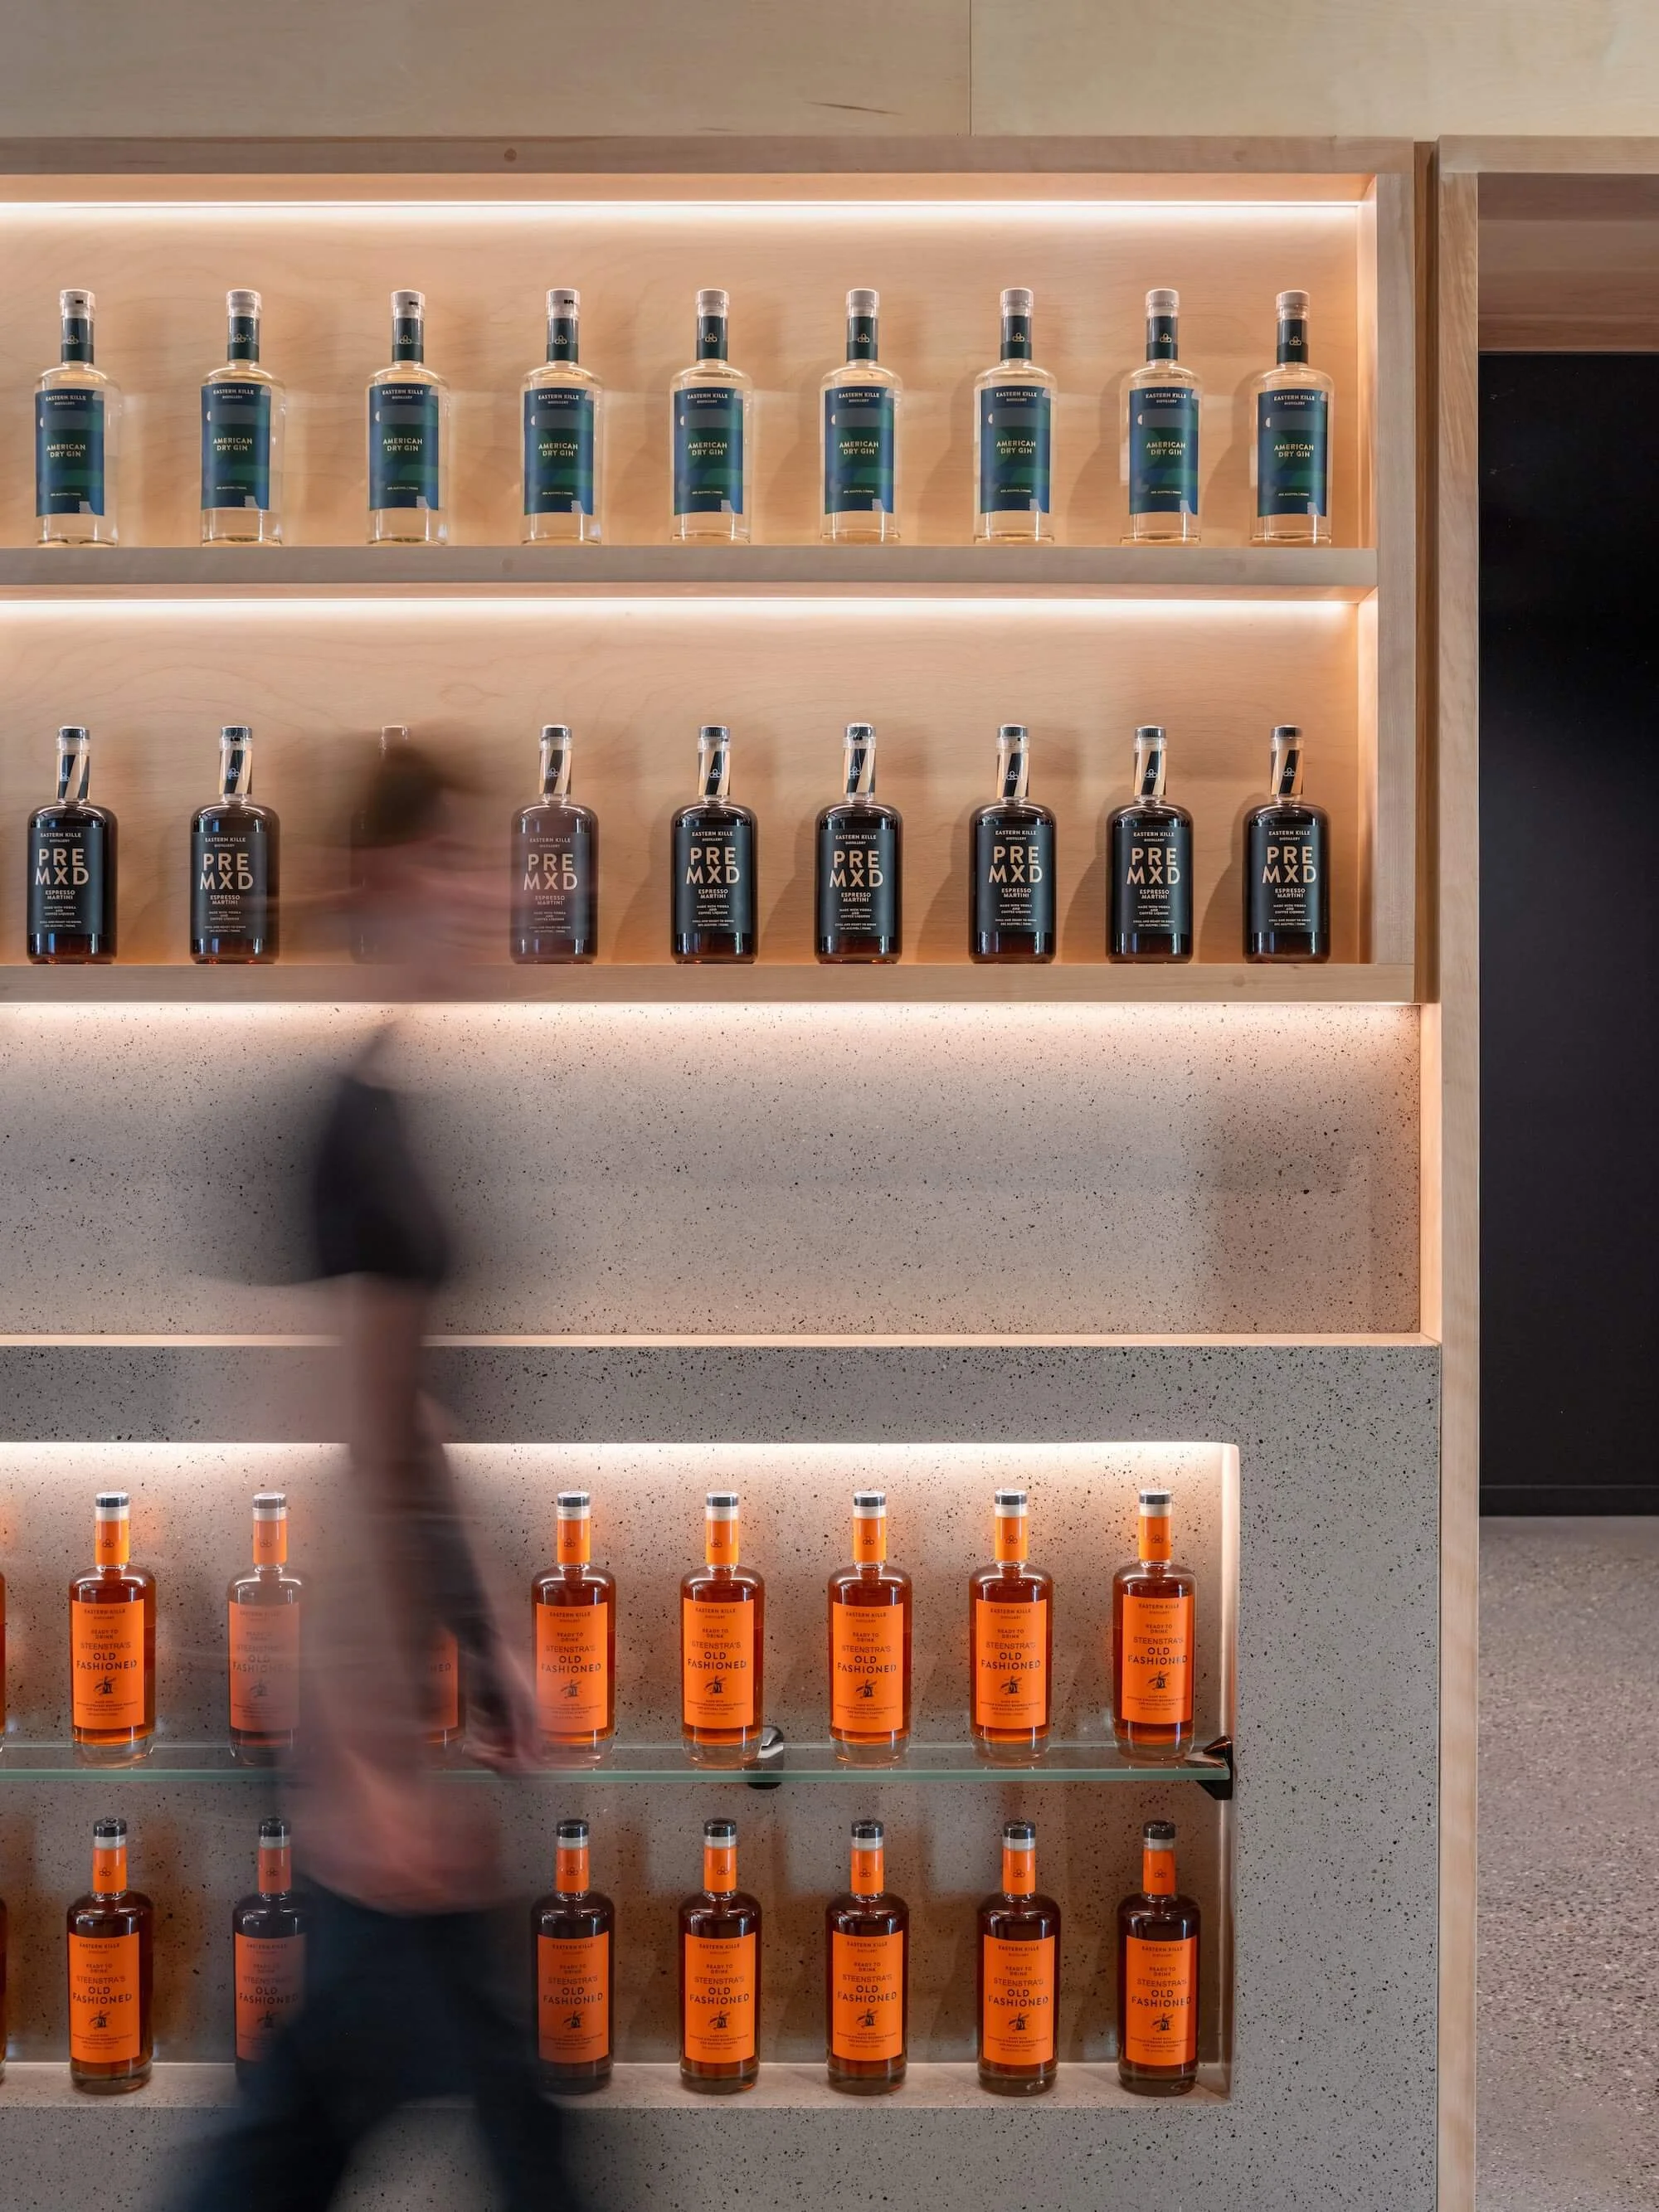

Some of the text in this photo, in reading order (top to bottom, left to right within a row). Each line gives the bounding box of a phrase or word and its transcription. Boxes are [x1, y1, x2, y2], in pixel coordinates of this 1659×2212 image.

[37, 848, 82, 866] PRE
[690, 847, 735, 864] PRE
[833, 851, 878, 868] PRE
[994, 846, 1039, 863] PRE
[1131, 848, 1177, 865] PRE
[1267, 846, 1312, 864] PRE
[202, 853, 247, 871] PRE
[528, 853, 572, 871] PRE
[32, 867, 86, 885] MXD
[685, 866, 739, 883] MXD
[828, 869, 883, 887] MXD
[989, 865, 1043, 882] MXD
[1126, 867, 1180, 884] MXD
[1262, 865, 1316, 882] MXD
[197, 872, 251, 890] MXD
[523, 873, 577, 890] MXD
[94, 1652, 115, 1660] OLD
[559, 1655, 581, 1664] OLD
[704, 1651, 726, 1660] OLD
[854, 1655, 876, 1664] OLD
[1129, 1654, 1188, 1665] FASHIONED
[76, 1659, 135, 1670] FASHIONED
[541, 1662, 601, 1673] FASHIONED
[686, 1657, 745, 1669] FASHIONED
[836, 1662, 896, 1673] FASHIONED
[981, 1659, 1040, 1670] FASHIONED
[88, 1986, 109, 1995] OLD
[856, 1985, 878, 1993] OLD
[1008, 1989, 1029, 1997] OLD
[71, 1992, 131, 2004] FASHIONED
[543, 1993, 602, 2005] FASHIONED
[690, 1993, 749, 2005] FASHIONED
[838, 1991, 897, 2002] FASHIONED
[989, 1996, 1048, 2006] FASHIONED
[1133, 1996, 1192, 2007] FASHIONED
